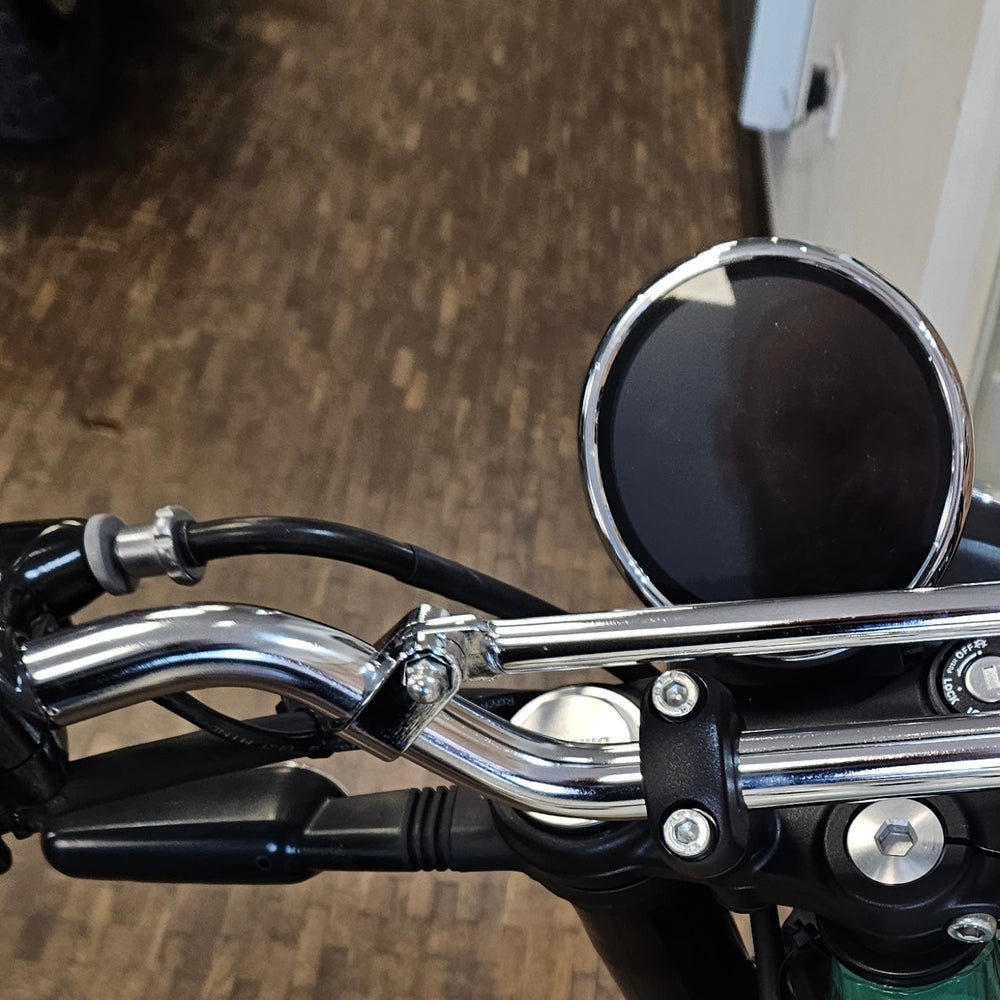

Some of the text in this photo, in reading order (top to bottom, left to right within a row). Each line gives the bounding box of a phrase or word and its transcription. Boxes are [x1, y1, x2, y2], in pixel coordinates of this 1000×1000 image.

[955, 644, 975, 660] OFF
[946, 658, 958, 674] PUSH
[943, 677, 961, 706] LOCK
